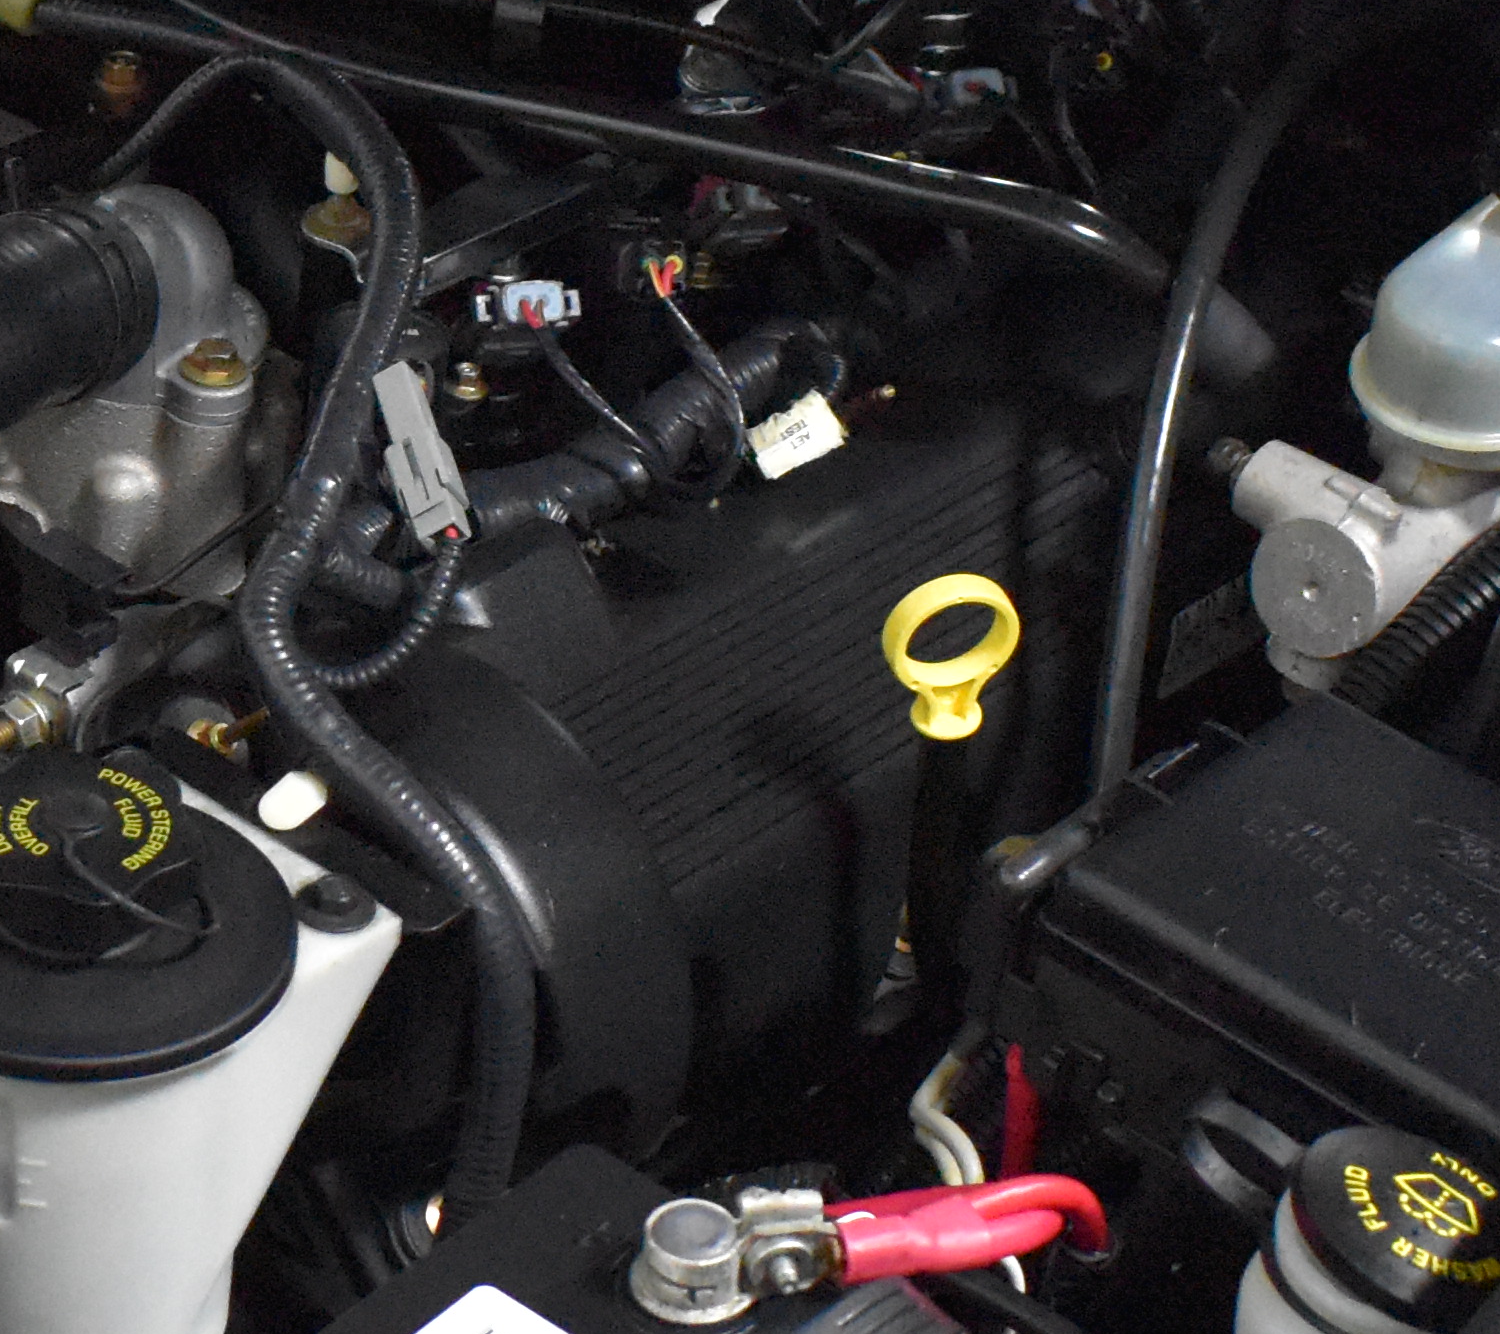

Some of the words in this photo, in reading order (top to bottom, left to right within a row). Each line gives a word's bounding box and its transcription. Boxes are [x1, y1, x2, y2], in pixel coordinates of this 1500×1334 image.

[779, 419, 808, 441] TEST
[98, 768, 163, 808] POWER
[9, 798, 50, 857] OVERFILL
[113, 798, 145, 839] FLUID
[121, 809, 173, 872] STEERING
[1344, 1164, 1390, 1232] FLUID
[1430, 1152, 1499, 1200] ONLY
